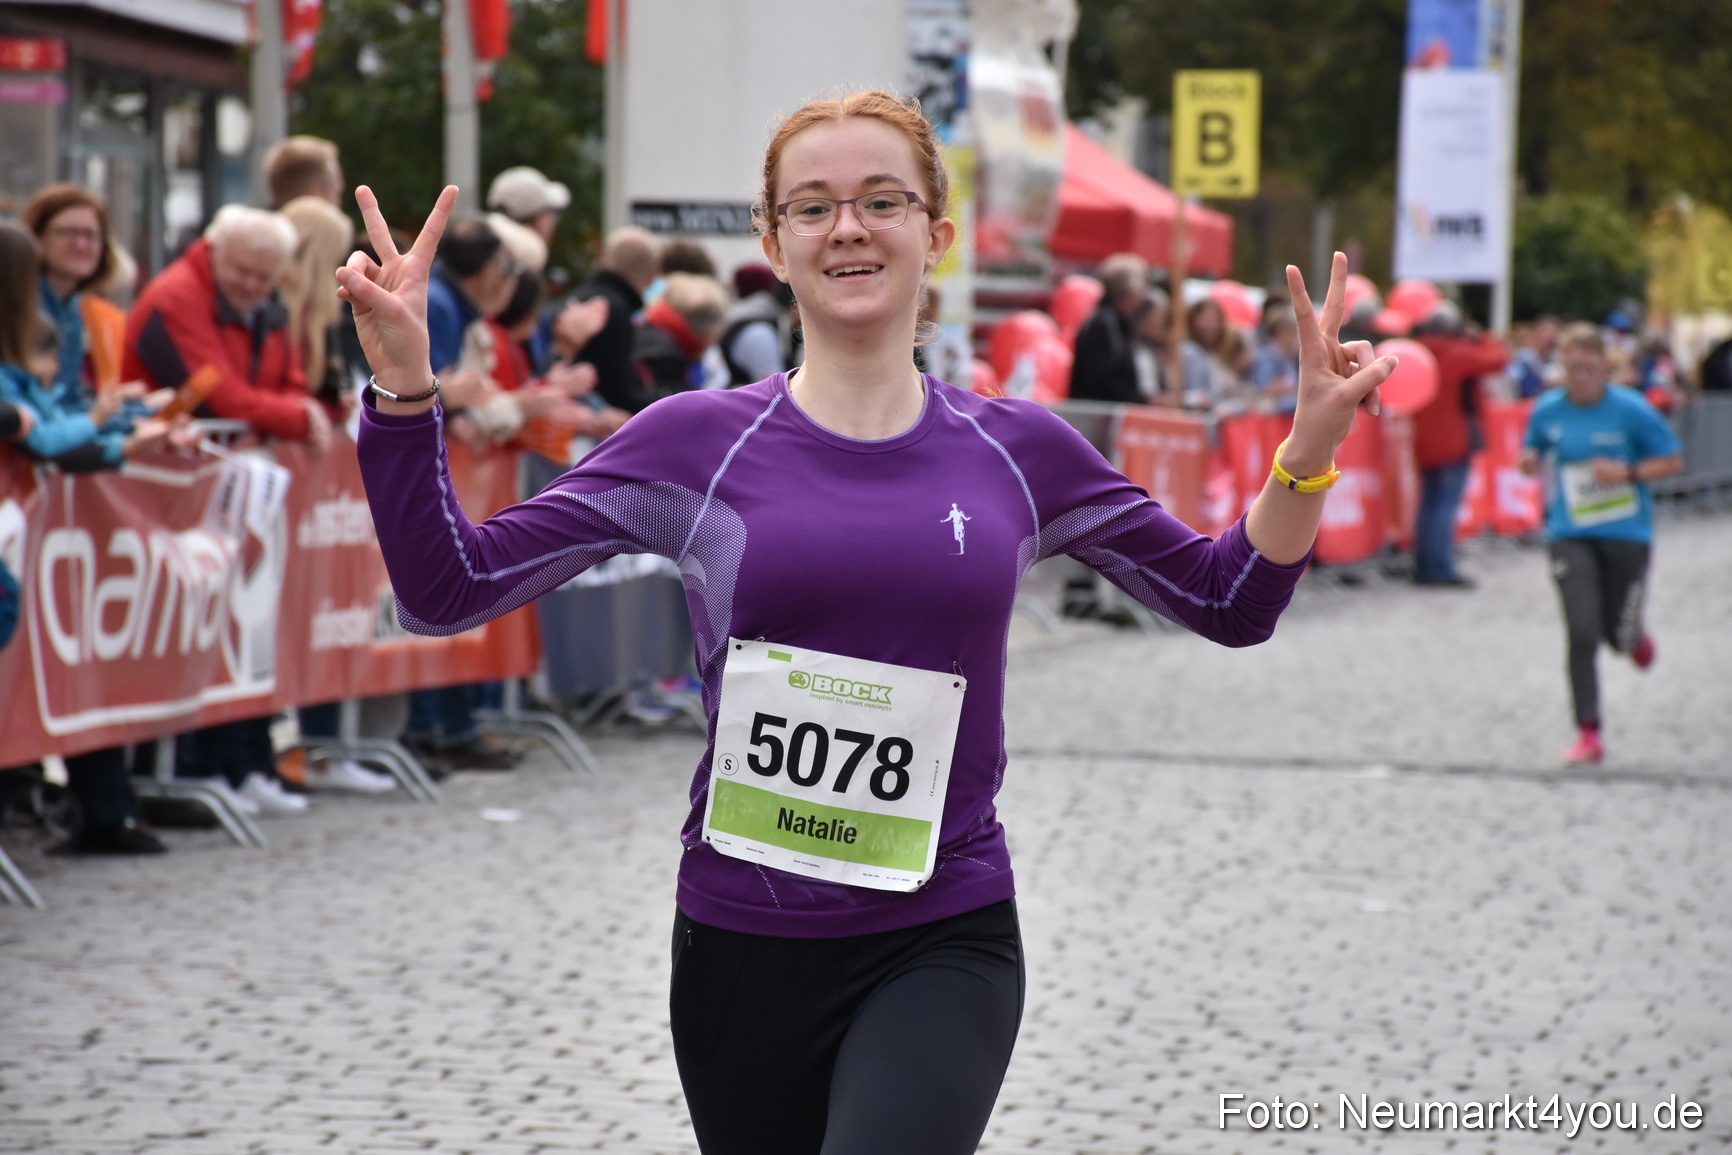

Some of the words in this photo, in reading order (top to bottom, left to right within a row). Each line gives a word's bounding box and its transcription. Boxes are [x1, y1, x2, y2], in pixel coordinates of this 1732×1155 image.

[1198, 111, 1236, 168] B
[809, 692, 834, 701] inspired
[845, 699, 862, 707] smart
[864, 703, 892, 711] concepts
[811, 674, 893, 704] BOCK
[724, 758, 732, 771] S
[747, 712, 914, 802] 5078
[777, 807, 858, 845] Natalie
